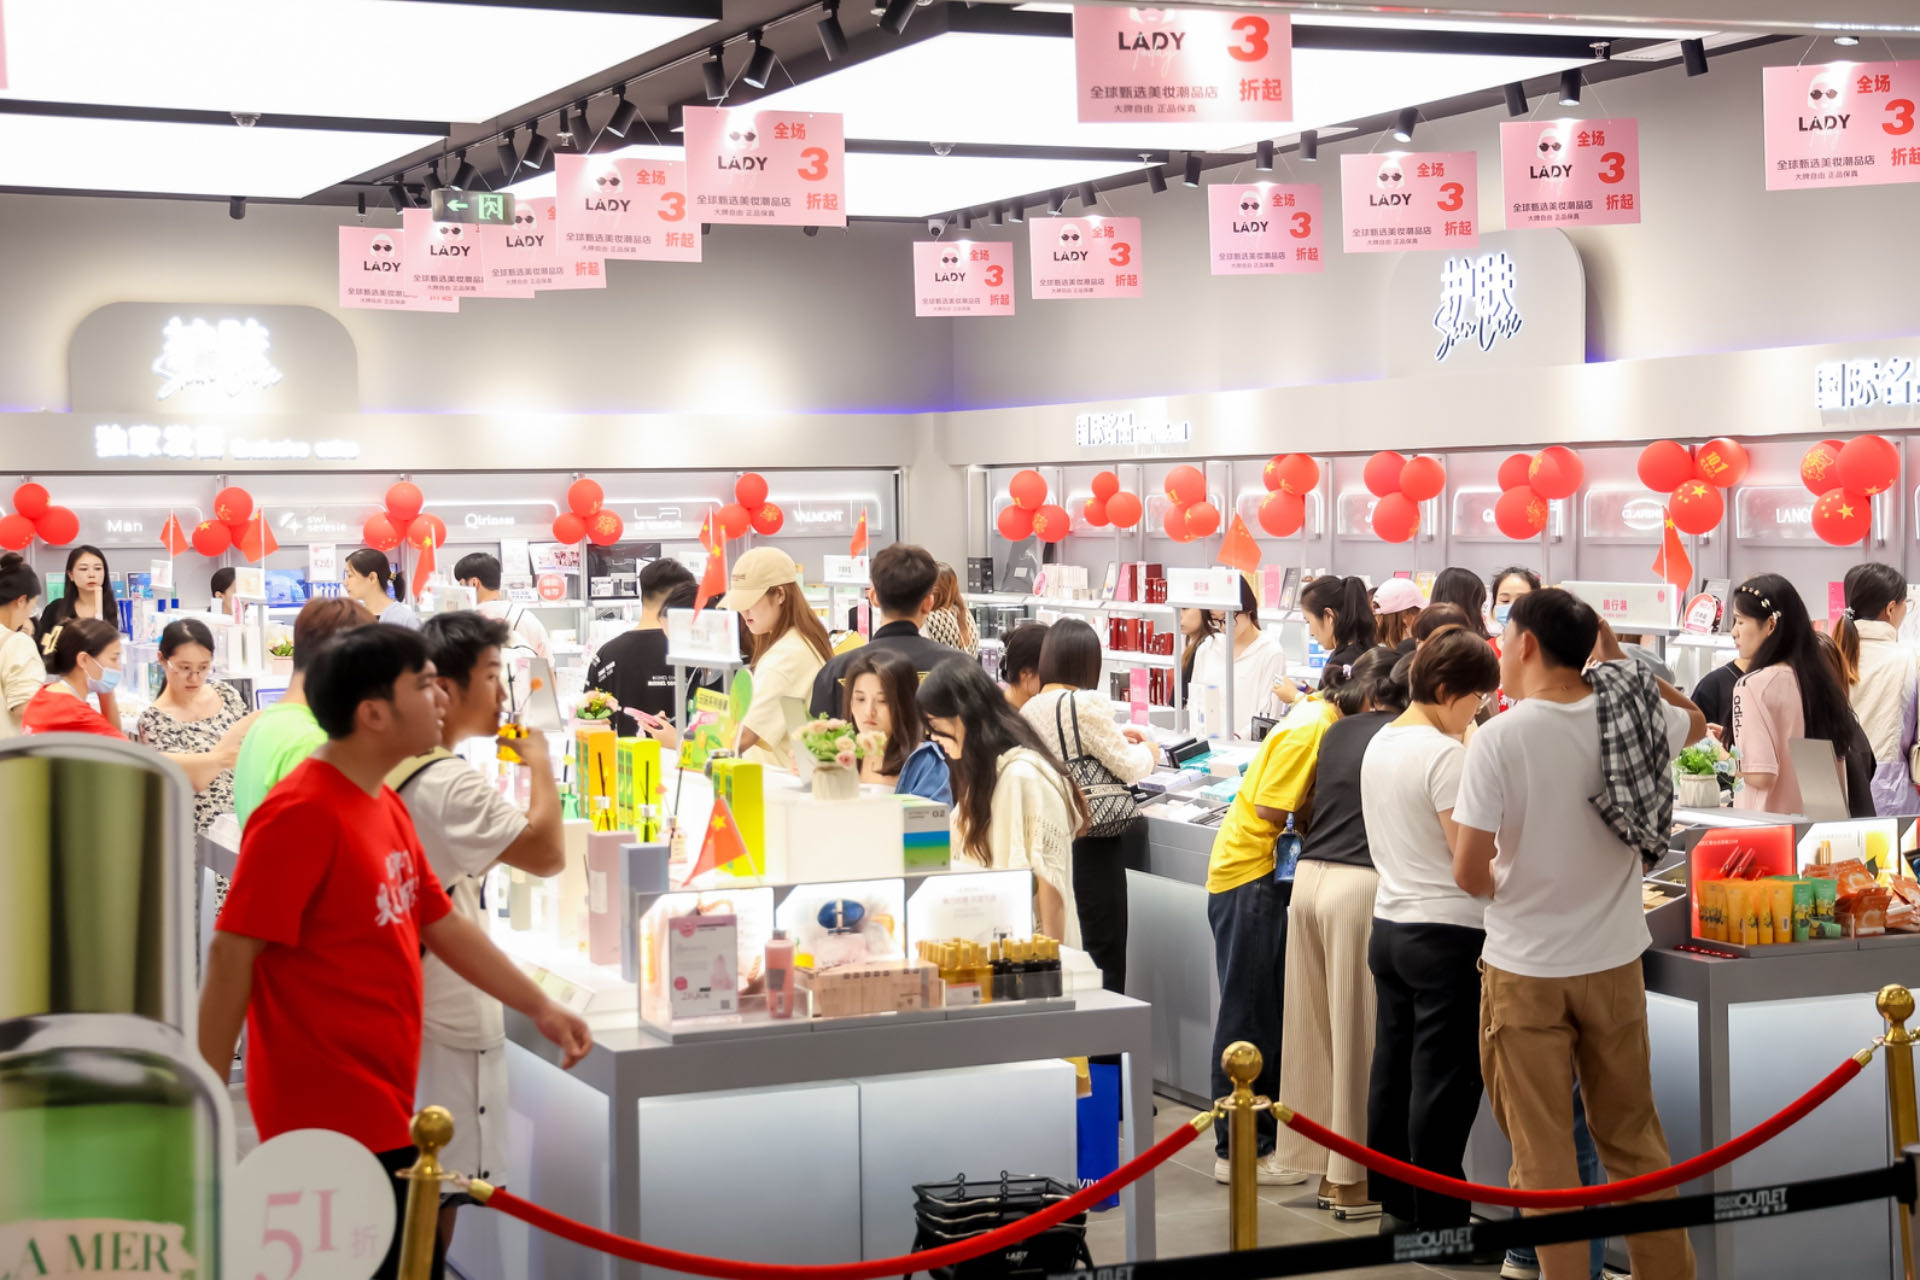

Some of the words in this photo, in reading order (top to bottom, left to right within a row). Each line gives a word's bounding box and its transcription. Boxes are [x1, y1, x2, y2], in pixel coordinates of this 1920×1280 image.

[1118, 32, 1185, 50] LADY
[1227, 16, 1270, 62] 3
[1240, 79, 1282, 101] 折起
[1857, 74, 1891, 94] 全场
[1091, 86, 1217, 99] 全球甄选美妆潮品店
[1114, 104, 1153, 114] 大牌自由
[1157, 104, 1196, 113] 正品保真
[1882, 98, 1915, 136] 3
[774, 122, 806, 140] 全场
[1799, 114, 1851, 132] LADY
[1577, 130, 1605, 148] 全场
[718, 155, 768, 171] LADY
[797, 147, 829, 181] 3
[1777, 155, 1875, 171] 全球甄选美妆潮品店
[1891, 147, 1920, 167] 折起
[1417, 162, 1445, 178] 全场
[1530, 164, 1573, 179] LADY
[1598, 152, 1625, 184] 3
[637, 169, 666, 185] 全场
[585, 198, 631, 212] LADY
[697, 195, 791, 208] 全球甄选美妆潮品店
[806, 193, 839, 211] 折起
[1272, 193, 1295, 207] 全场
[1369, 193, 1412, 207] LADY
[1436, 182, 1465, 212] 3
[1606, 194, 1634, 211] 折起
[658, 192, 686, 222] 3
[1513, 200, 1593, 213] 全球甄选美妆潮品店
[1092, 226, 1115, 239] 全场
[1232, 221, 1269, 233] LADY
[1289, 212, 1312, 239] 3
[1444, 221, 1472, 237] 折起
[506, 235, 544, 248] LADY
[665, 232, 695, 248] 折起
[430, 245, 470, 257] LADY
[970, 249, 990, 262] 全场
[1053, 251, 1089, 262] LADY
[1109, 242, 1131, 267] 3
[1296, 247, 1319, 261] 折起
[364, 261, 401, 272] LADY
[575, 262, 599, 276] 折起
[935, 272, 966, 282] LADY
[984, 265, 1004, 287] 3
[1115, 274, 1138, 287] 折起
[990, 294, 1010, 306] 折起
[1816, 356, 1920, 409] 国际名
[1622, 507, 1664, 520] CLARIN
[1776, 508, 1813, 524] LANC
[107, 519, 143, 532] Man
[1733, 695, 1743, 738] adid
[262, 1188, 340, 1280] 51
[352, 1225, 378, 1258] 折
[65, 1231, 170, 1275] MER
